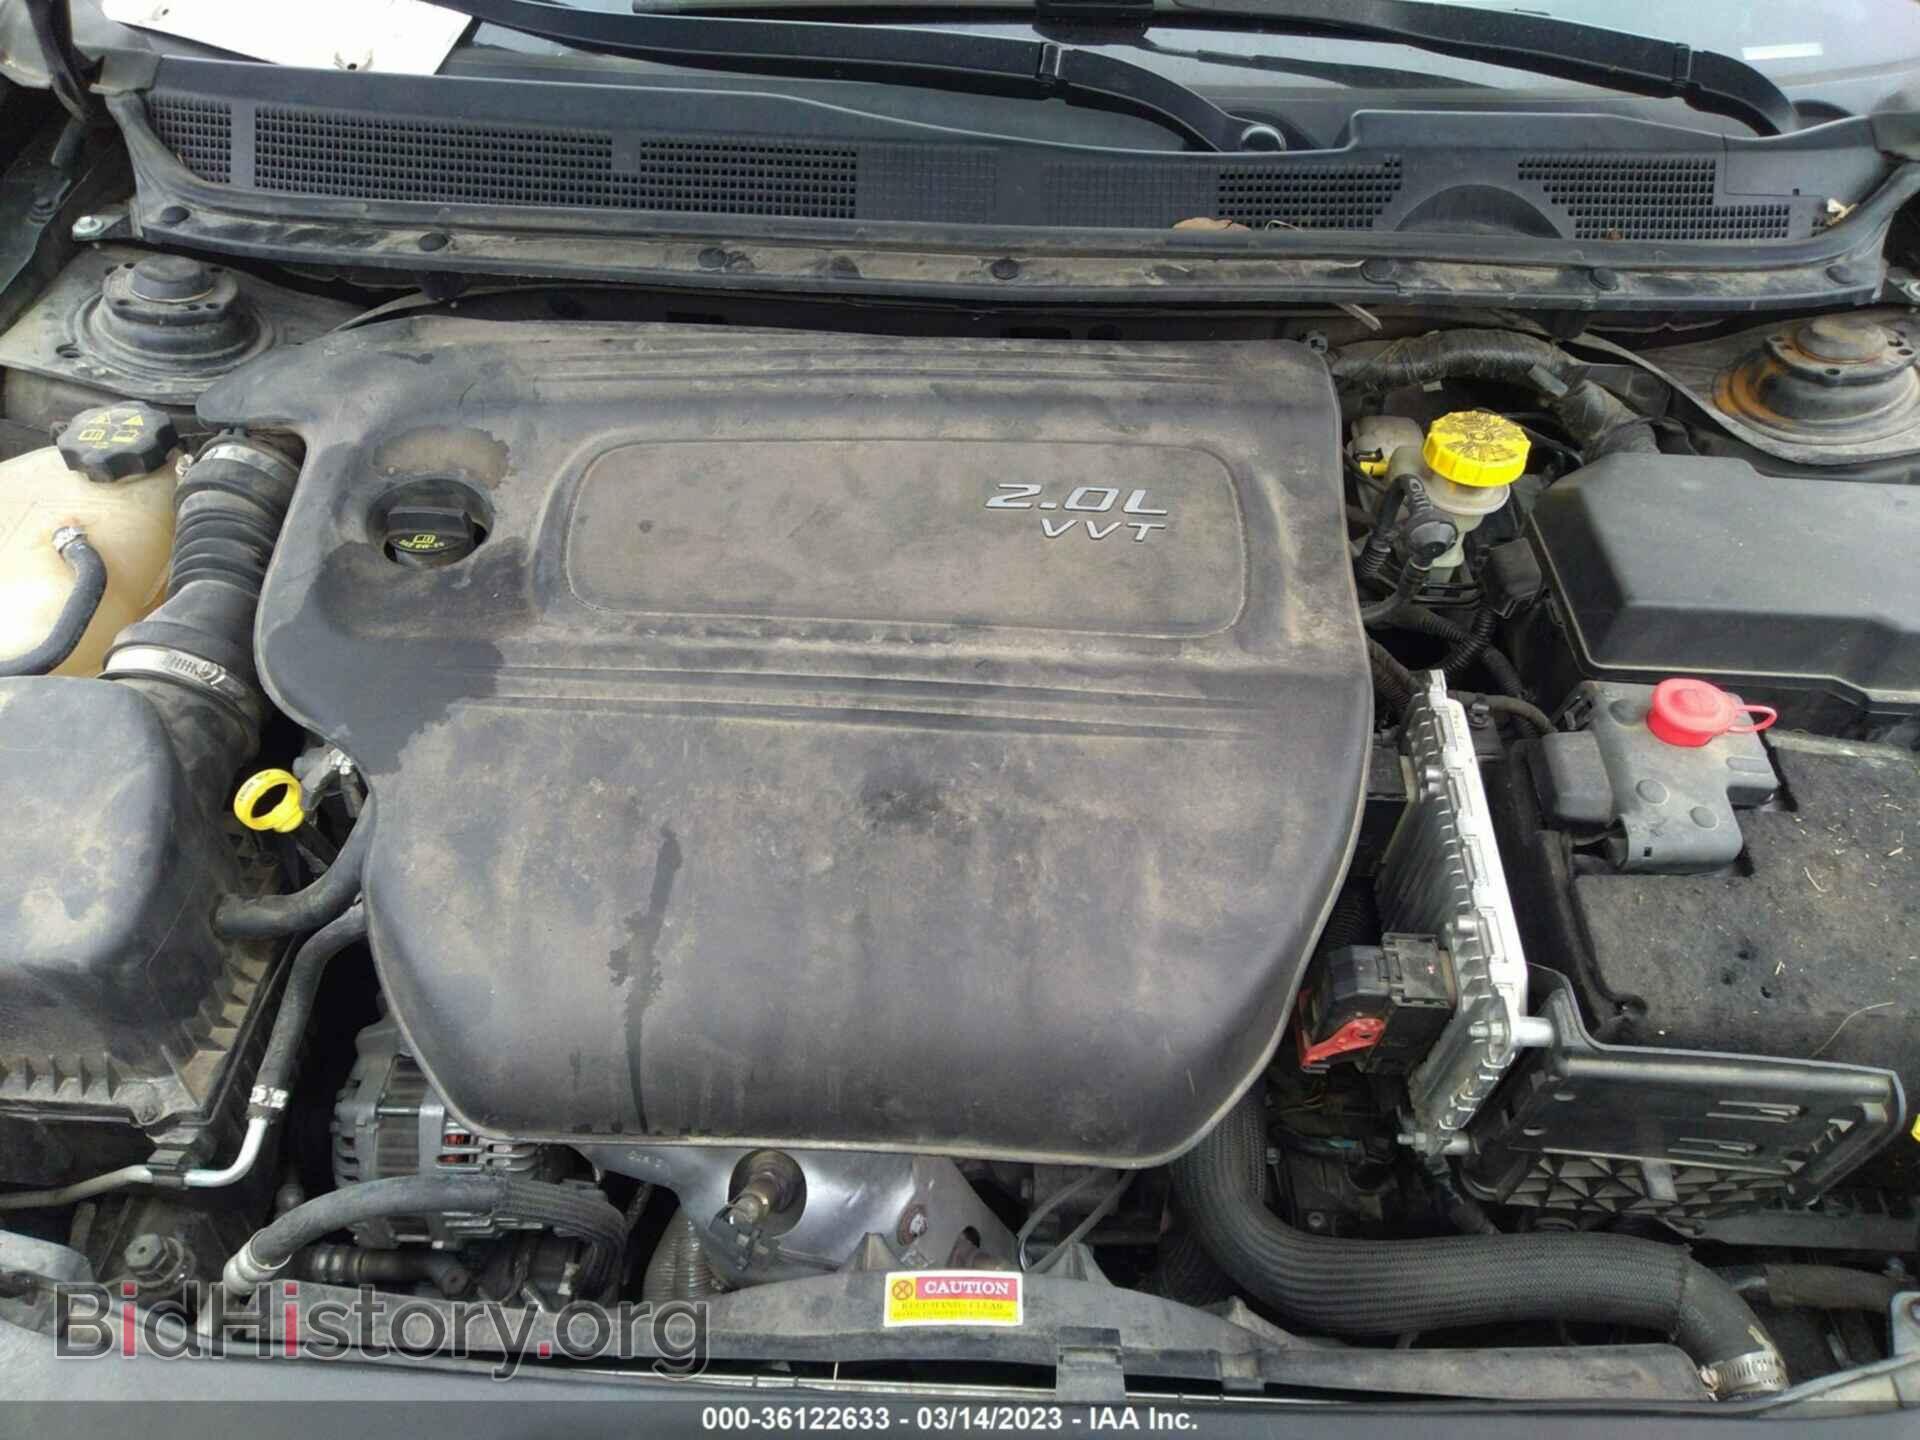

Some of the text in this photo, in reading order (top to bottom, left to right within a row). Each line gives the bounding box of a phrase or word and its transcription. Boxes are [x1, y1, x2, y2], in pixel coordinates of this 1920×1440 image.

[984, 483, 1168, 516] 2.0L
[1040, 518, 1166, 542] VVT
[924, 1281, 1009, 1295] CAUTION
